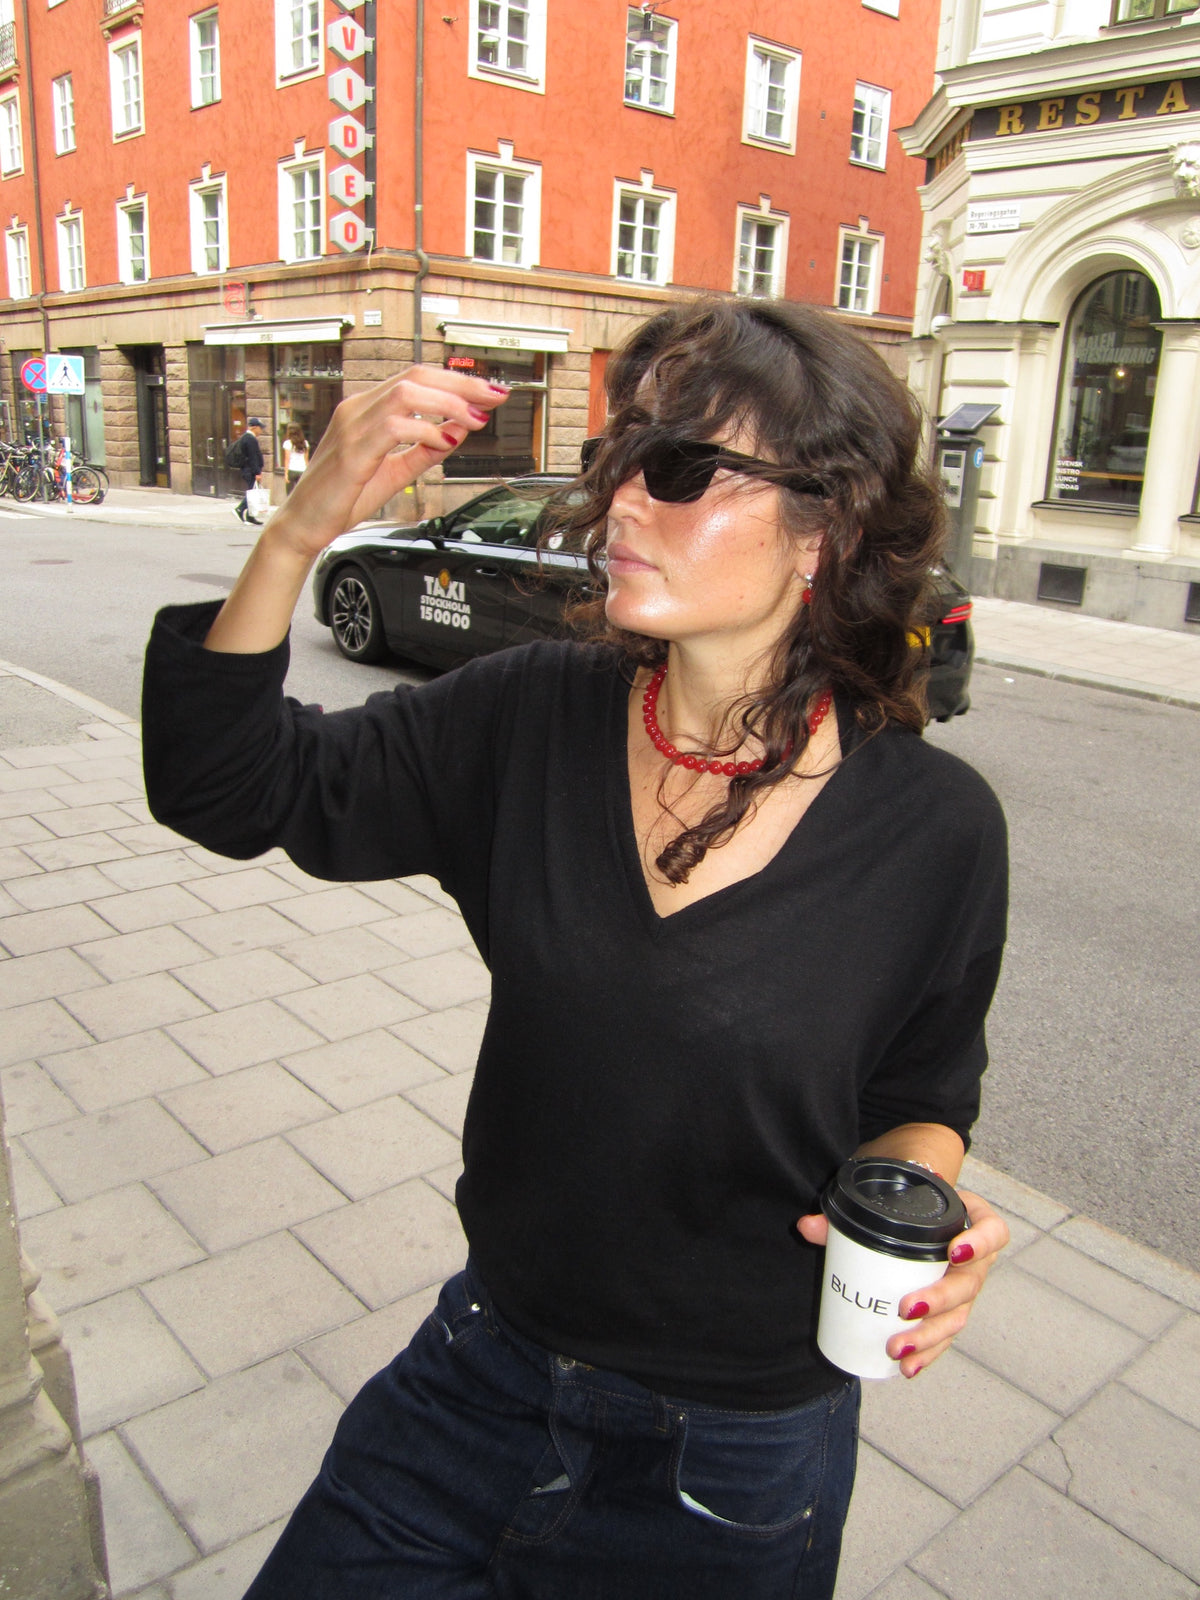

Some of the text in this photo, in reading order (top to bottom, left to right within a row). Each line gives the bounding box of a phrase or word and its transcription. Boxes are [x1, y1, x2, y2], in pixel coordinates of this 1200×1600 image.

[995, 81, 1190, 136] RESTA
[342, 26, 358, 244] VIDEO
[448, 357, 475, 368] amalia
[1056, 460, 1083, 468] SVENSK
[1056, 467, 1080, 475] BISTRO
[1055, 475, 1078, 483] LUNCH
[423, 575, 466, 602] TAXI
[420, 594, 471, 615] STOCKHOLM
[831, 1273, 892, 1316] BLUE
